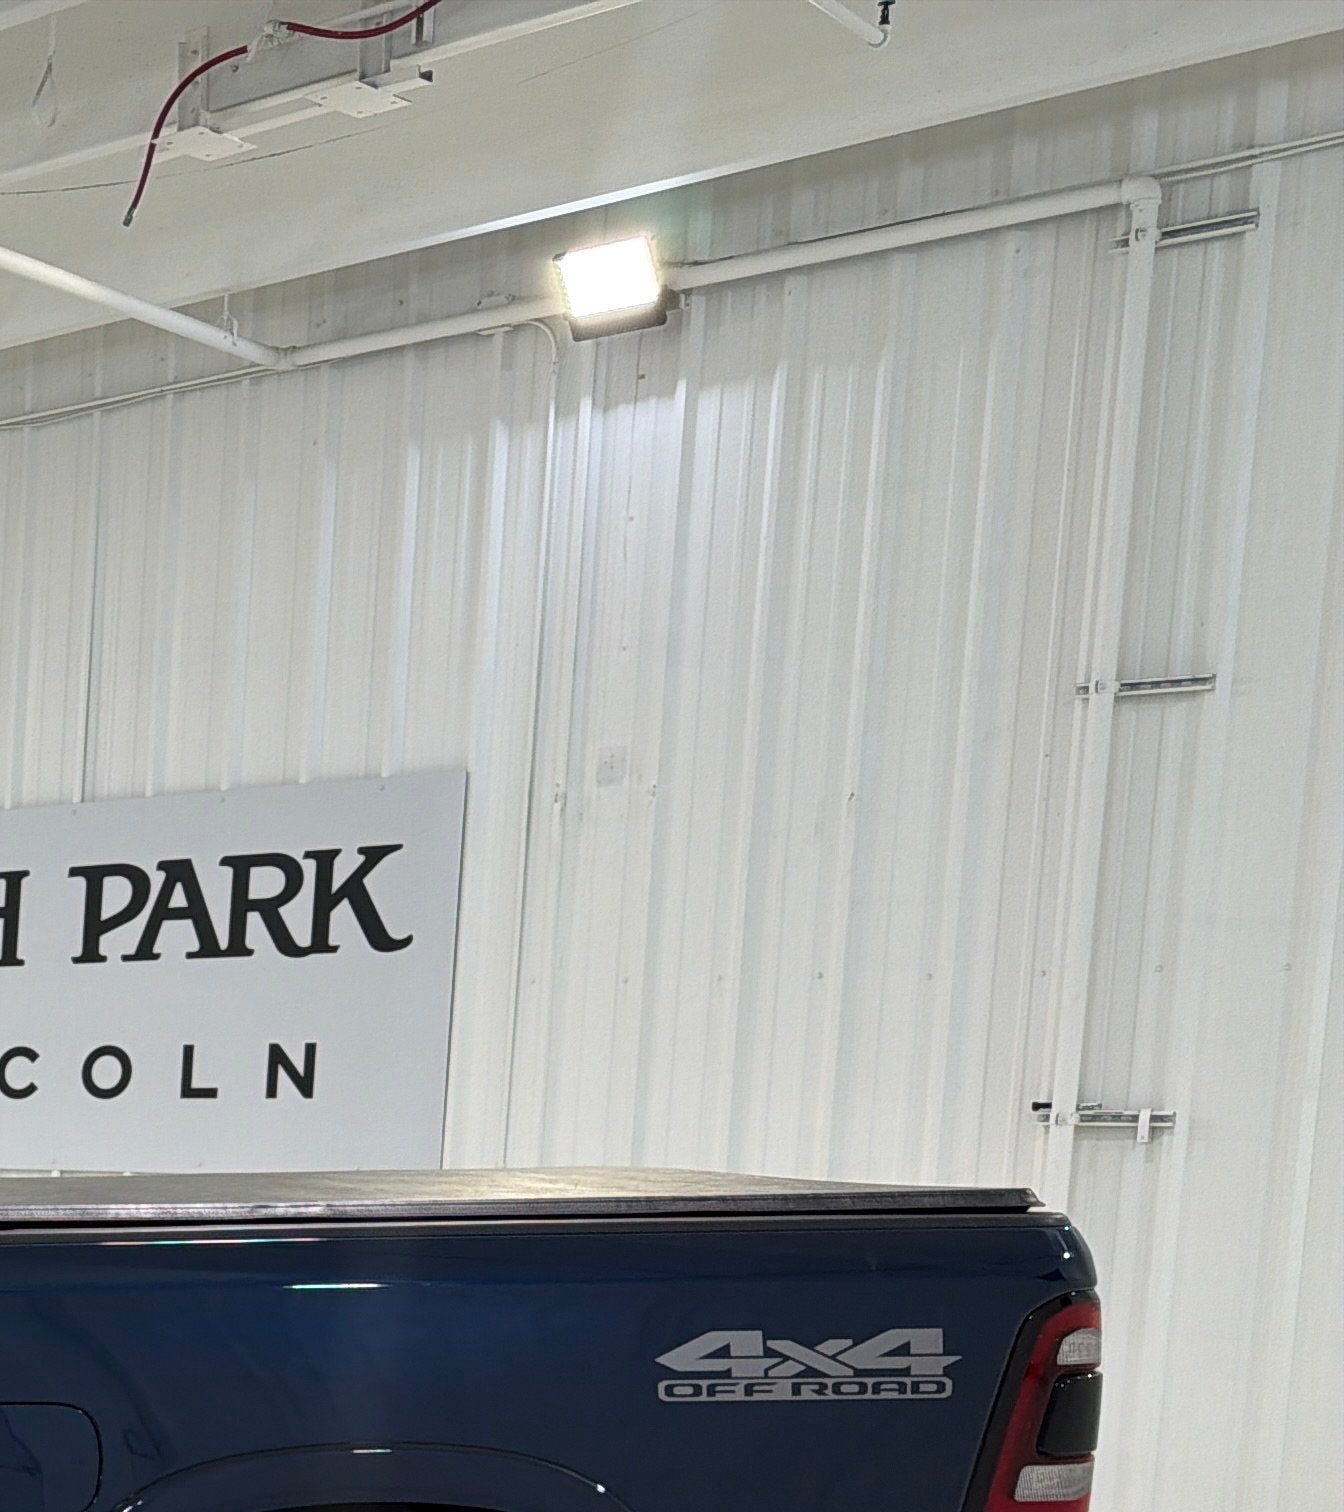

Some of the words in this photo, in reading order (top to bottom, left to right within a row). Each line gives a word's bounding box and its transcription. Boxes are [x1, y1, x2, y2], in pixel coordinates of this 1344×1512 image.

[68, 843, 413, 965] PARK
[663, 1381, 778, 1398] OFF
[792, 1379, 946, 1397] ROAD
